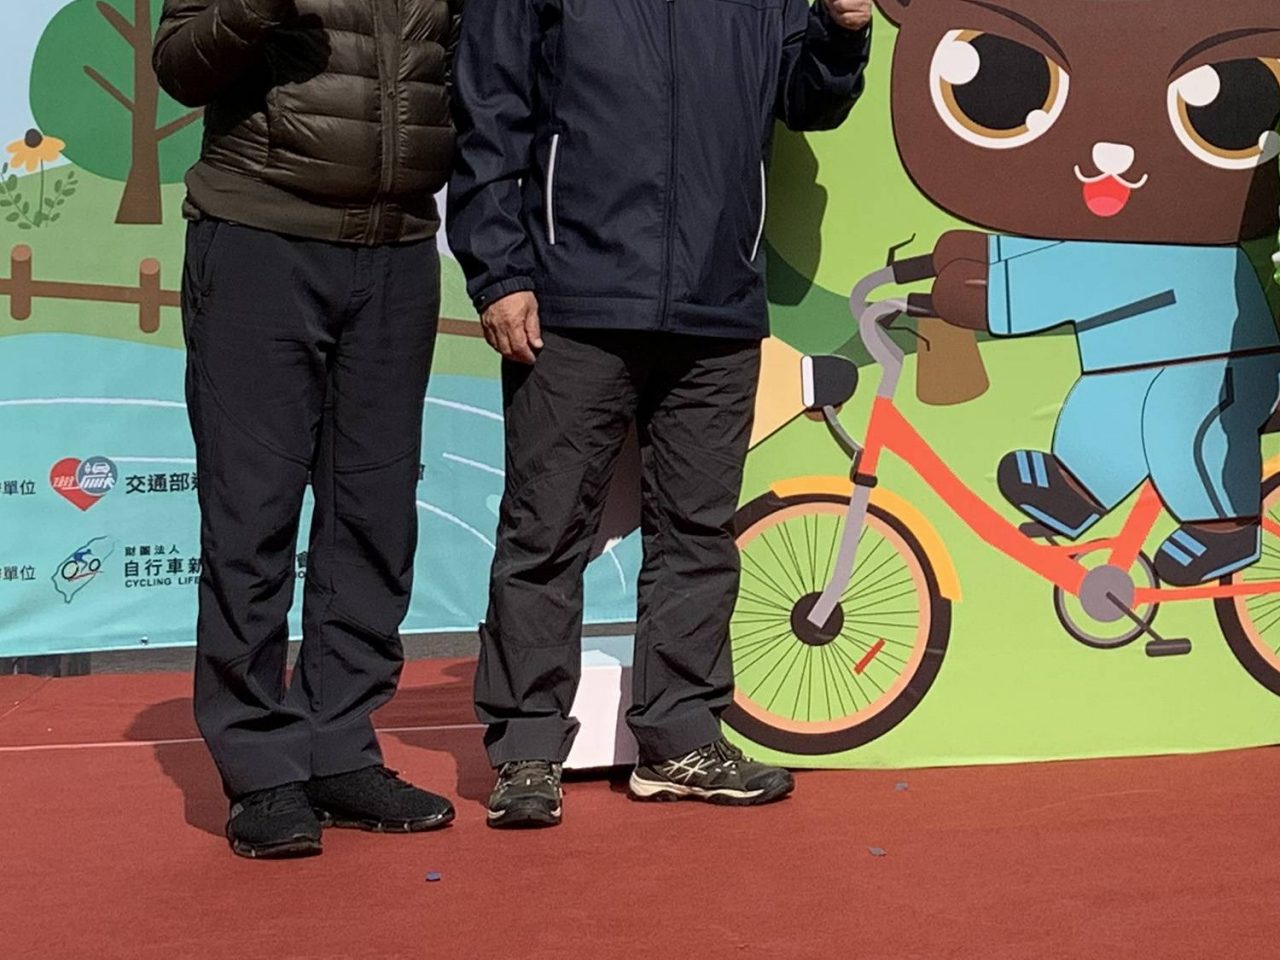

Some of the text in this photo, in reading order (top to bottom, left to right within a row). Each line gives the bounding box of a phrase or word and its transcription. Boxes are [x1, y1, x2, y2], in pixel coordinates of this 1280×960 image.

[0, 479, 37, 496] 單位
[0, 565, 37, 581] 單位
[124, 577, 172, 588] CYCLING
